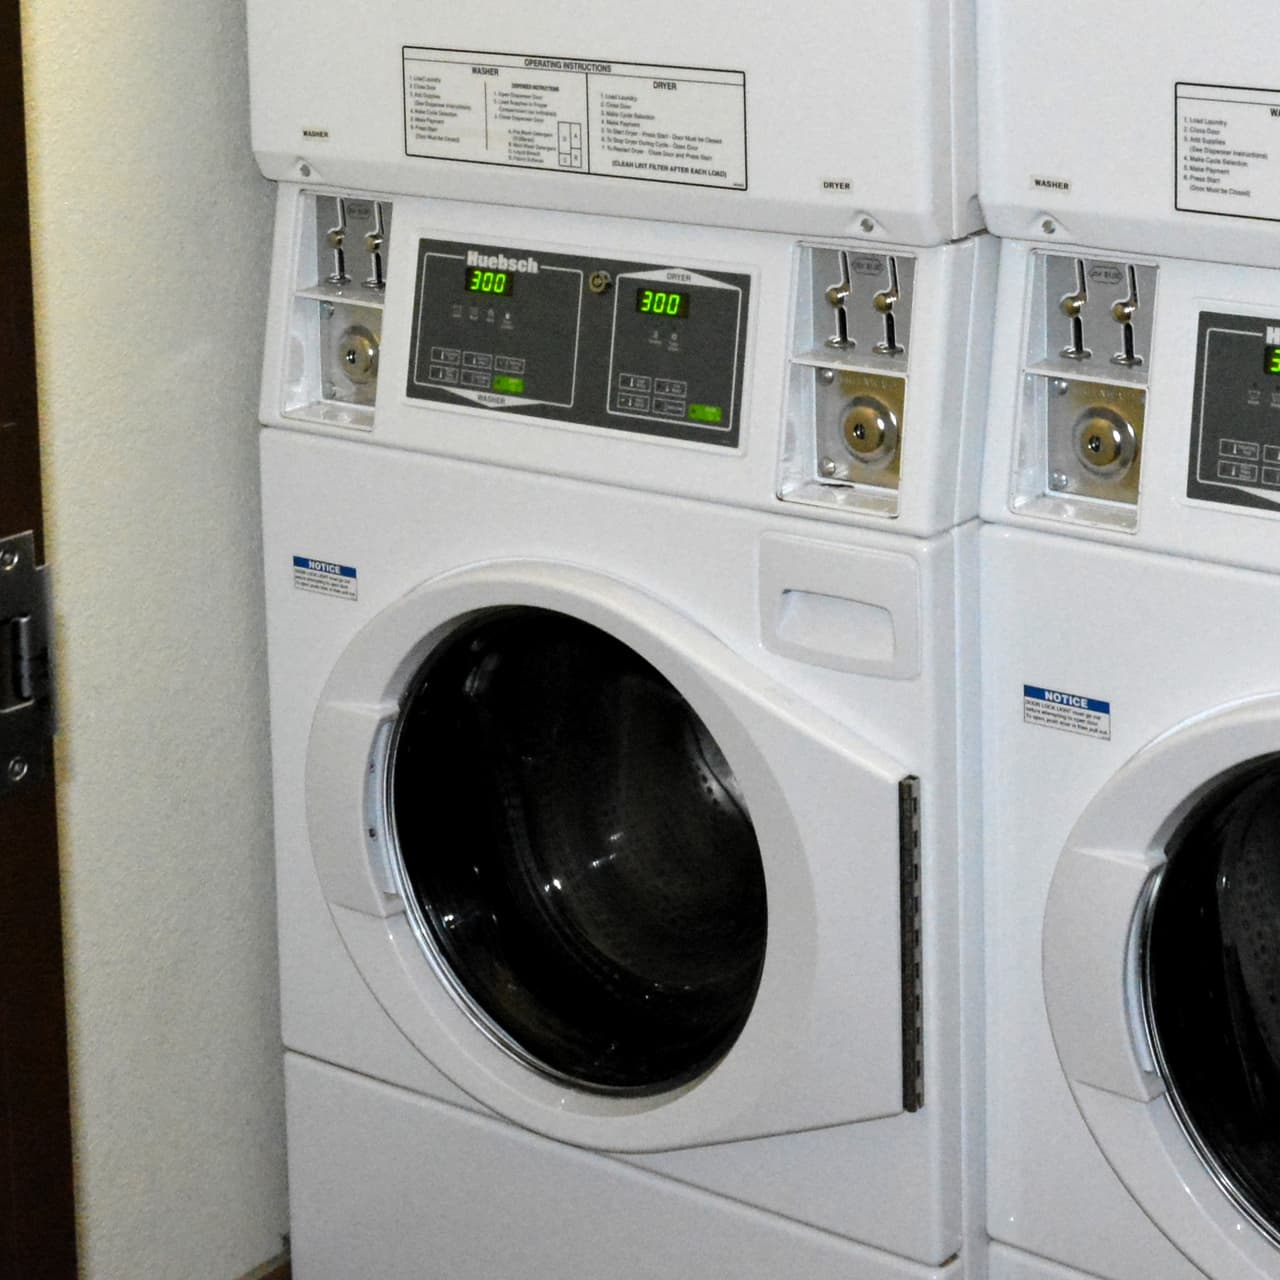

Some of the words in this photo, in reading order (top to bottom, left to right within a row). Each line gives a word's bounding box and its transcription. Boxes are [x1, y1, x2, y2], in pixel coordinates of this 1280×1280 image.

[472, 67, 498, 76] WASHER
[525, 59, 561, 68] OPERATING
[563, 61, 611, 72] INSTRUCTIONS
[653, 81, 677, 90] DRYER
[1035, 179, 1068, 189] WASHER
[467, 251, 538, 273] Huebsch
[471, 271, 506, 293] 300
[667, 273, 691, 281] DRYER
[641, 291, 680, 315] 300
[309, 560, 340, 573] NOTICE
[1045, 691, 1088, 708] NOTICE
